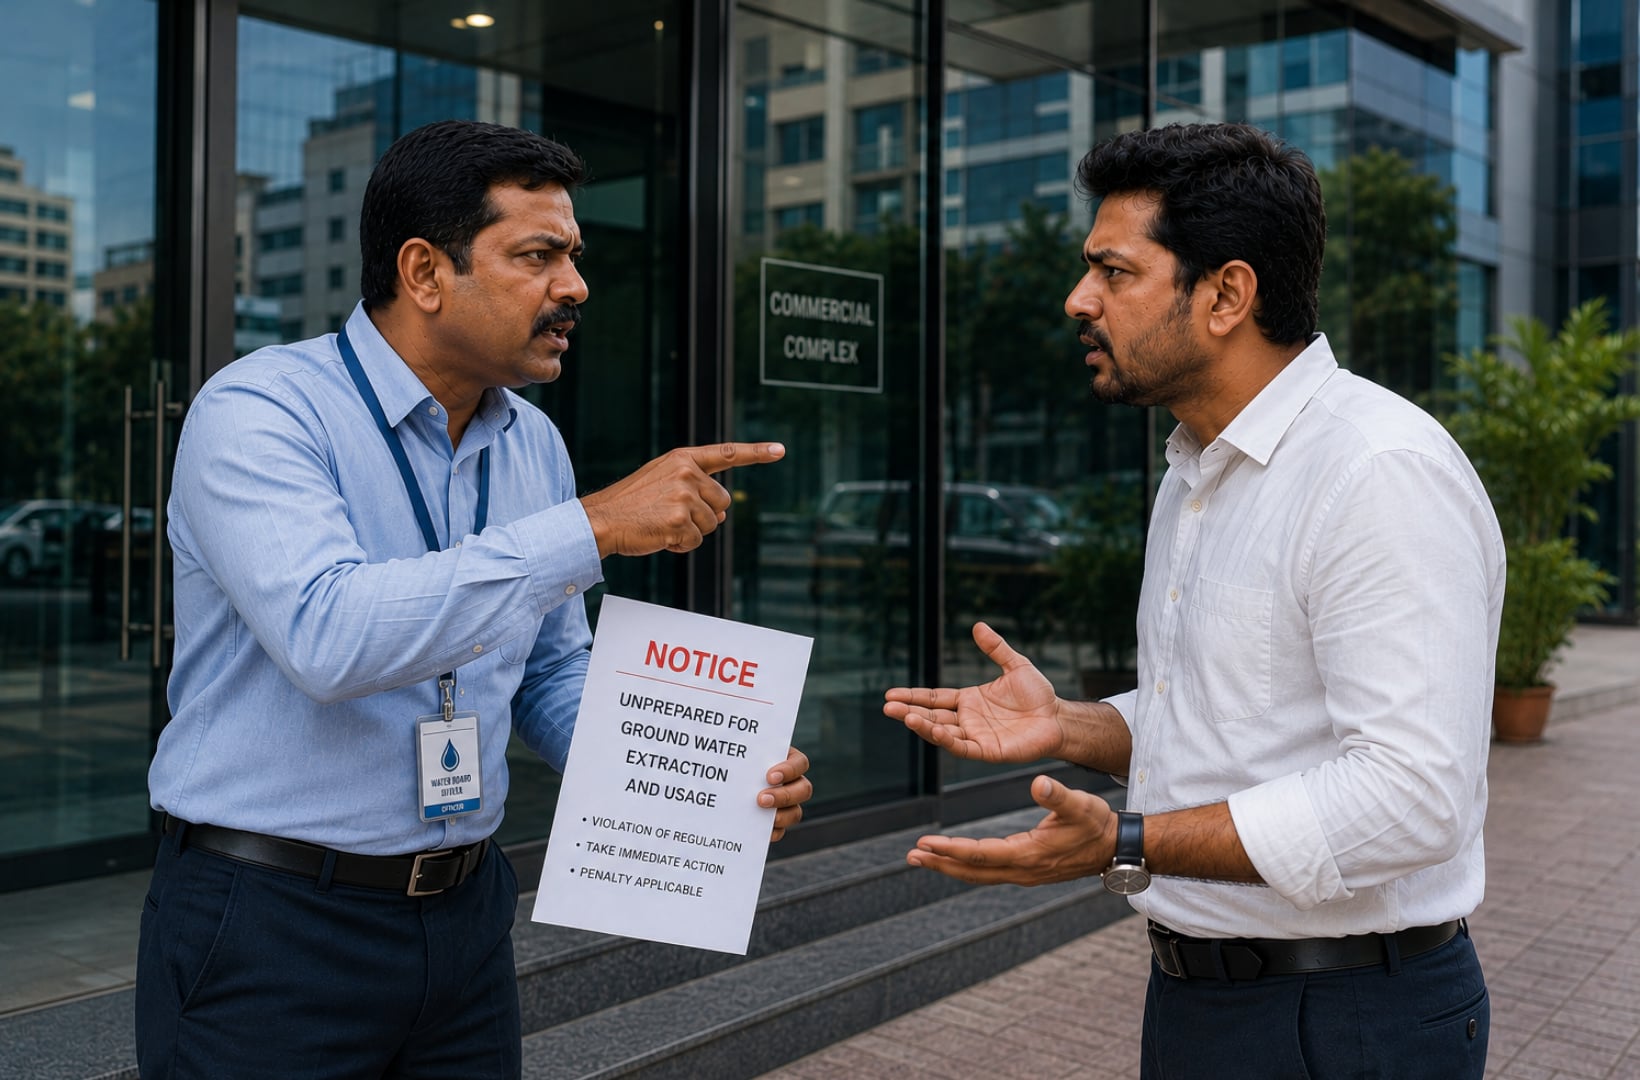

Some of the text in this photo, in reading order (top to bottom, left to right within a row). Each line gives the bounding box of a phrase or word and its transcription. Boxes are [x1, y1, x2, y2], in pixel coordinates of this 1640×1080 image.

[769, 291, 875, 327] COMMERCIAL
[783, 334, 859, 364] COMPLEX
[644, 640, 758, 688] NOTICE
[619, 692, 759, 734] UNPREPARED FOR
[621, 720, 747, 758] GROUND WATER
[625, 749, 729, 783] EXTRACTION
[624, 778, 717, 808] AND USAGE
[592, 816, 742, 853] VIOLATION OF REGULATION
[586, 841, 725, 875] TAKE IMMEDIATE ACTION
[580, 867, 703, 898] PENALTY APPLICABLE
